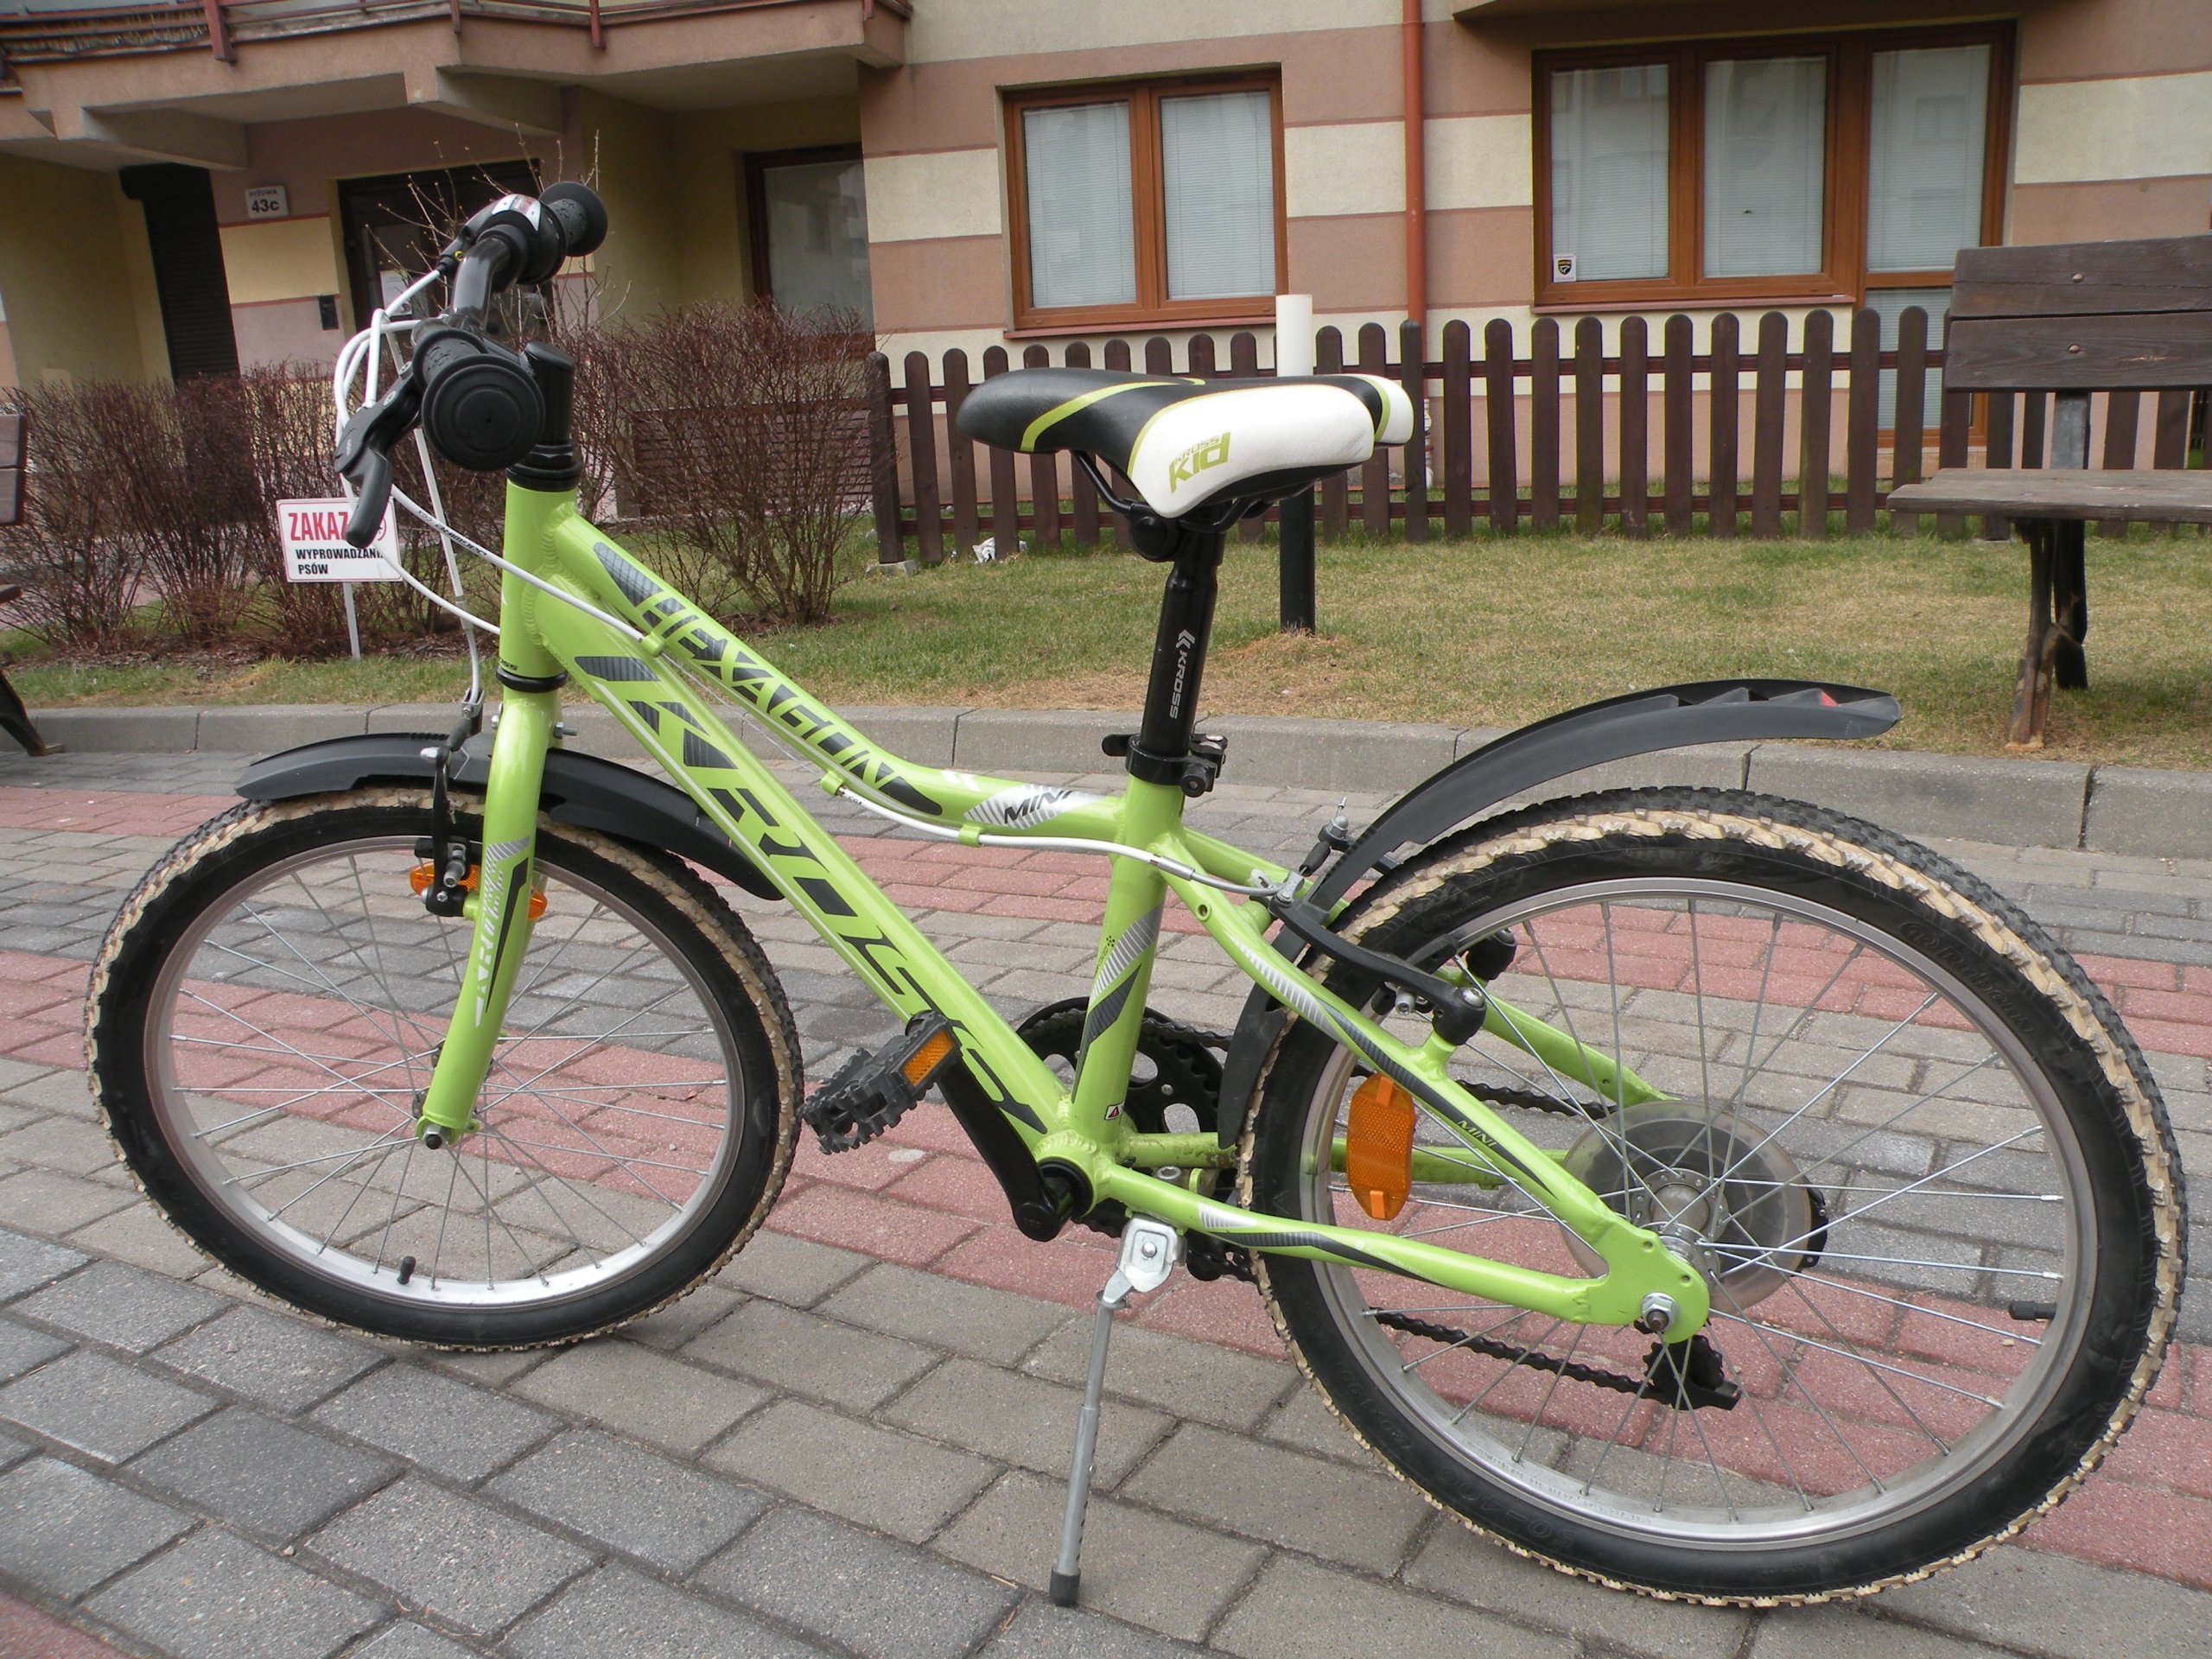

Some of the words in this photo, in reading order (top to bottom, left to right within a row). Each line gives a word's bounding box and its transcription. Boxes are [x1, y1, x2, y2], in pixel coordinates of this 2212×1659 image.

[251, 199, 280, 213] 43c
[1175, 435, 1220, 466] KROSS
[296, 548, 385, 560] WYPROWADZANI
[298, 562, 328, 575] PSÓW
[635, 591, 899, 786] HEXAGON
[1169, 650, 1188, 719] KROSS
[1004, 790, 1074, 824] MINI
[602, 662, 1039, 1122] KROSS
[1456, 1119, 1497, 1147] MINI
